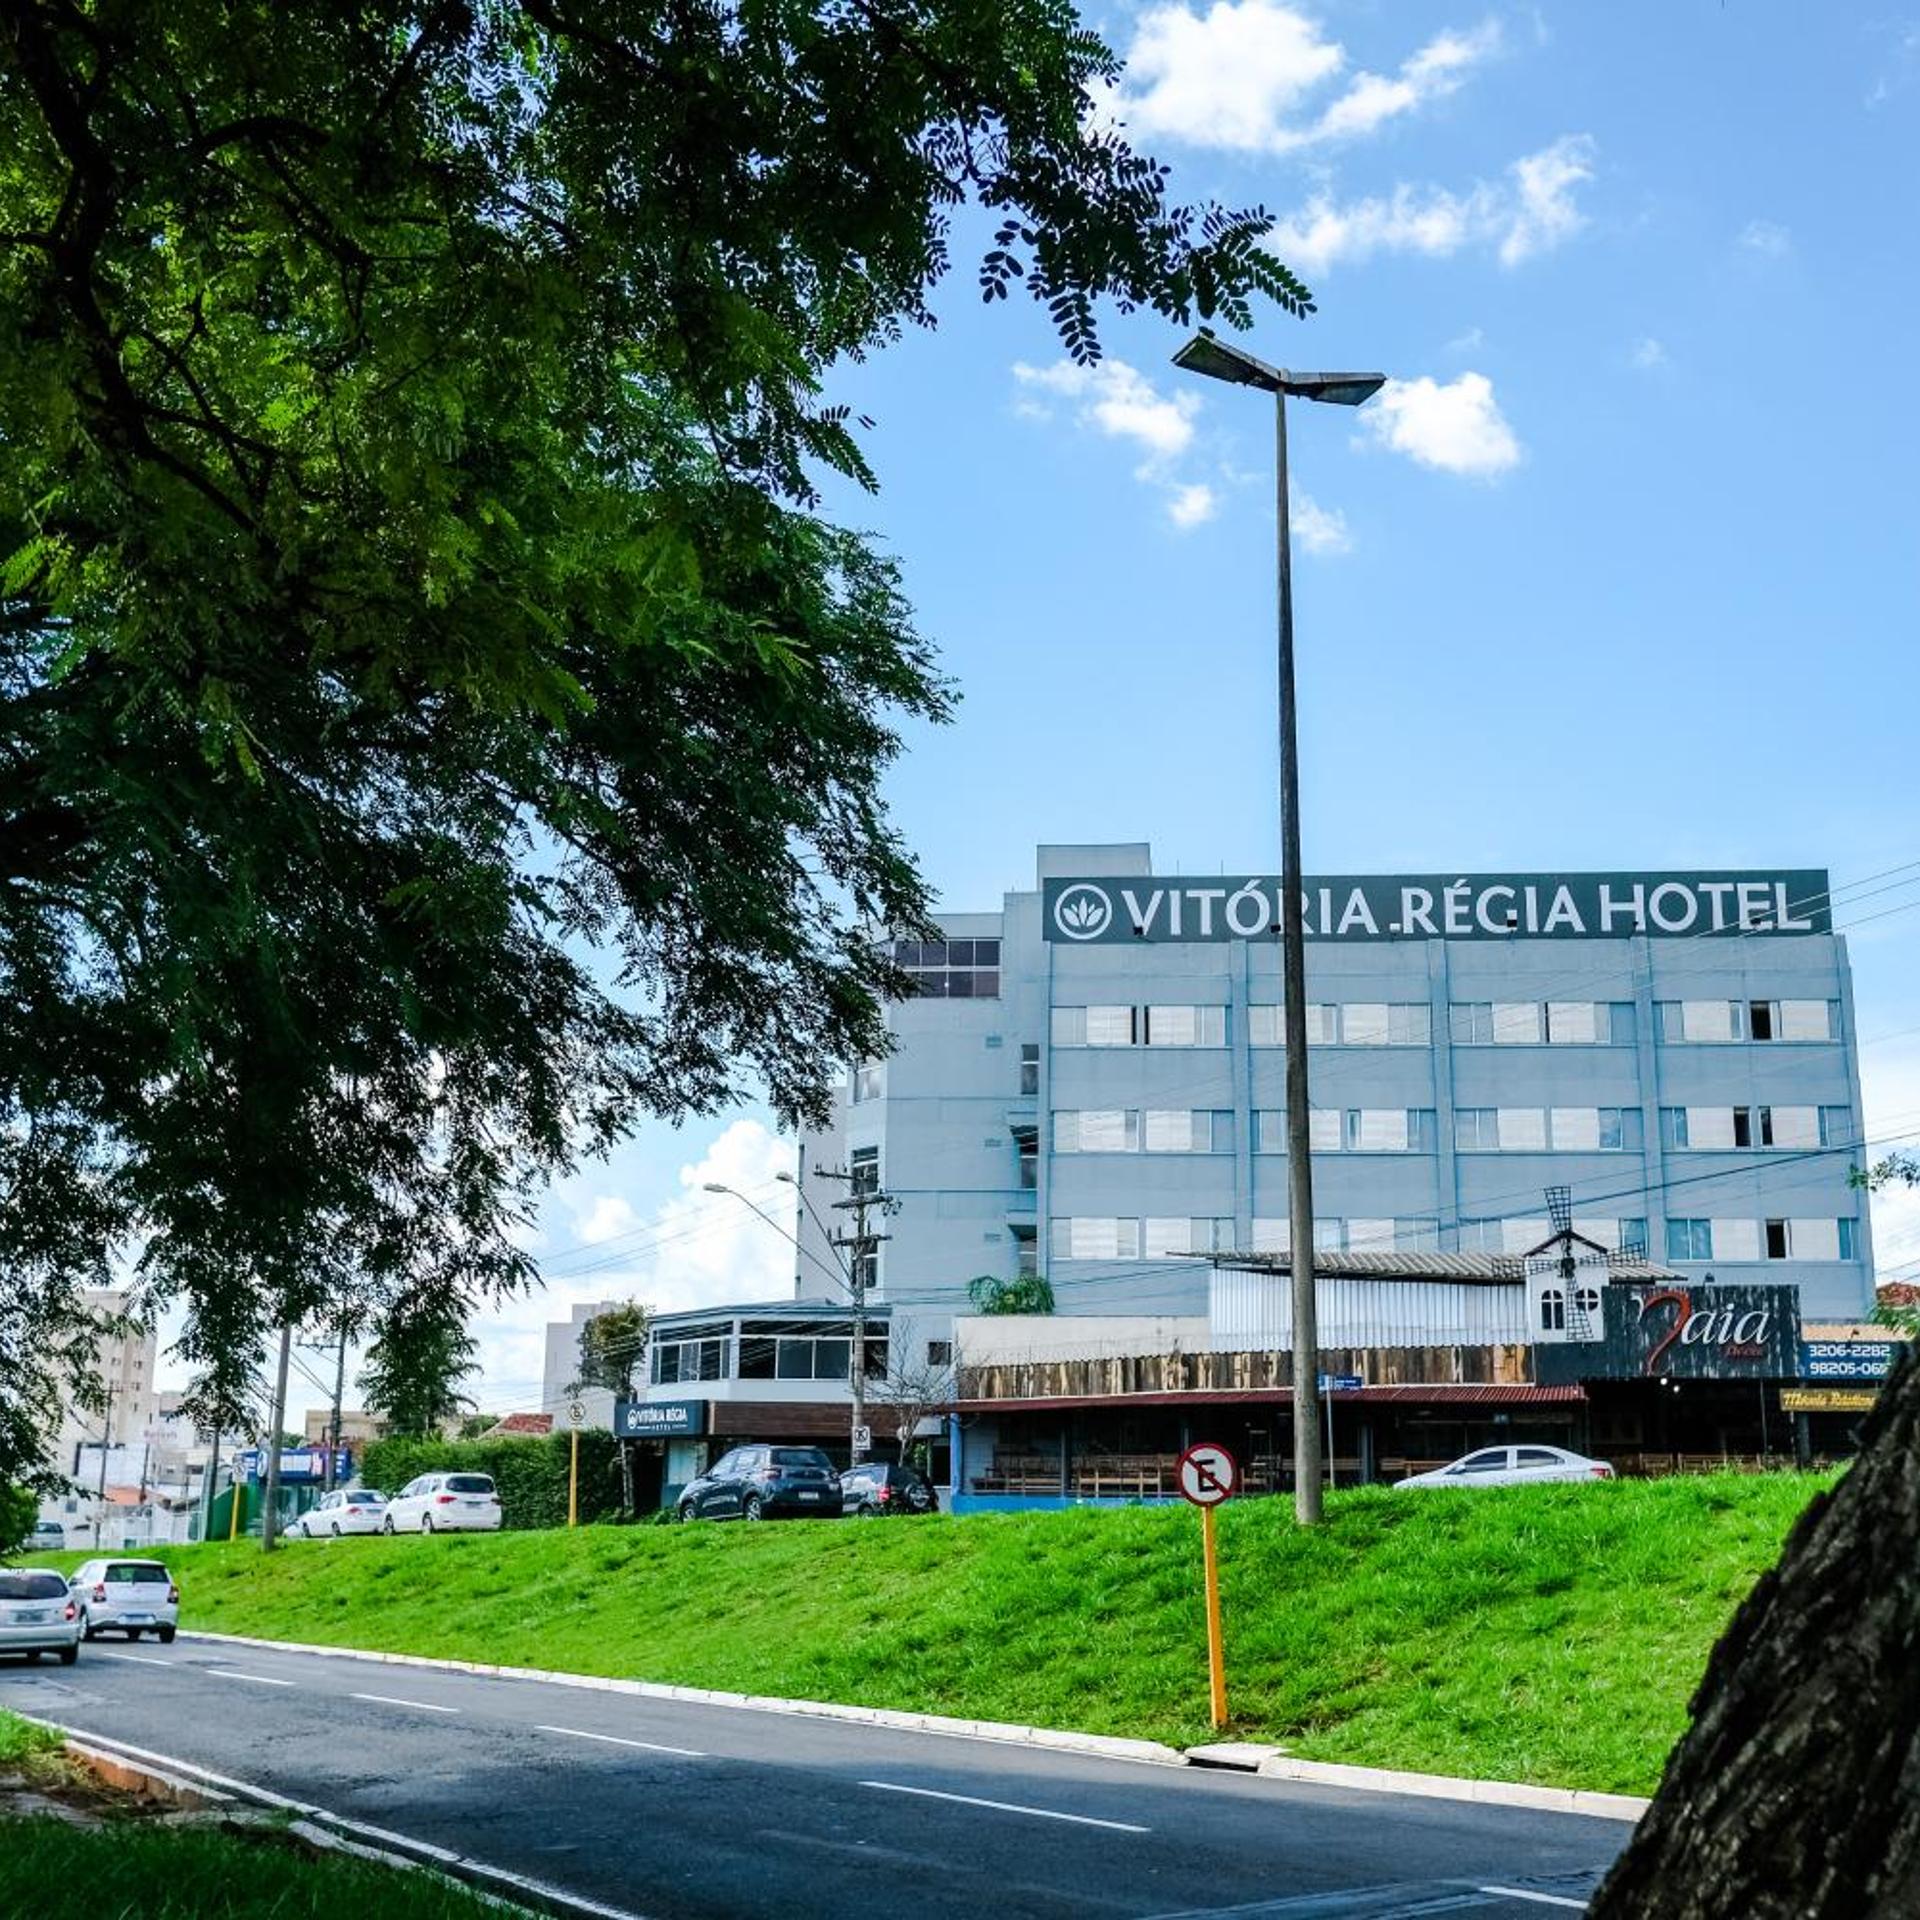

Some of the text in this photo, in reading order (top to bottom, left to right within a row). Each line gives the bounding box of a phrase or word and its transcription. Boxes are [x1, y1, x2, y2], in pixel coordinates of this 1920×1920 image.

[1401, 879, 1587, 934] RÉGIA
[1599, 882, 1812, 932] HOTEL
[1808, 1345, 1891, 1357] 3206-2282
